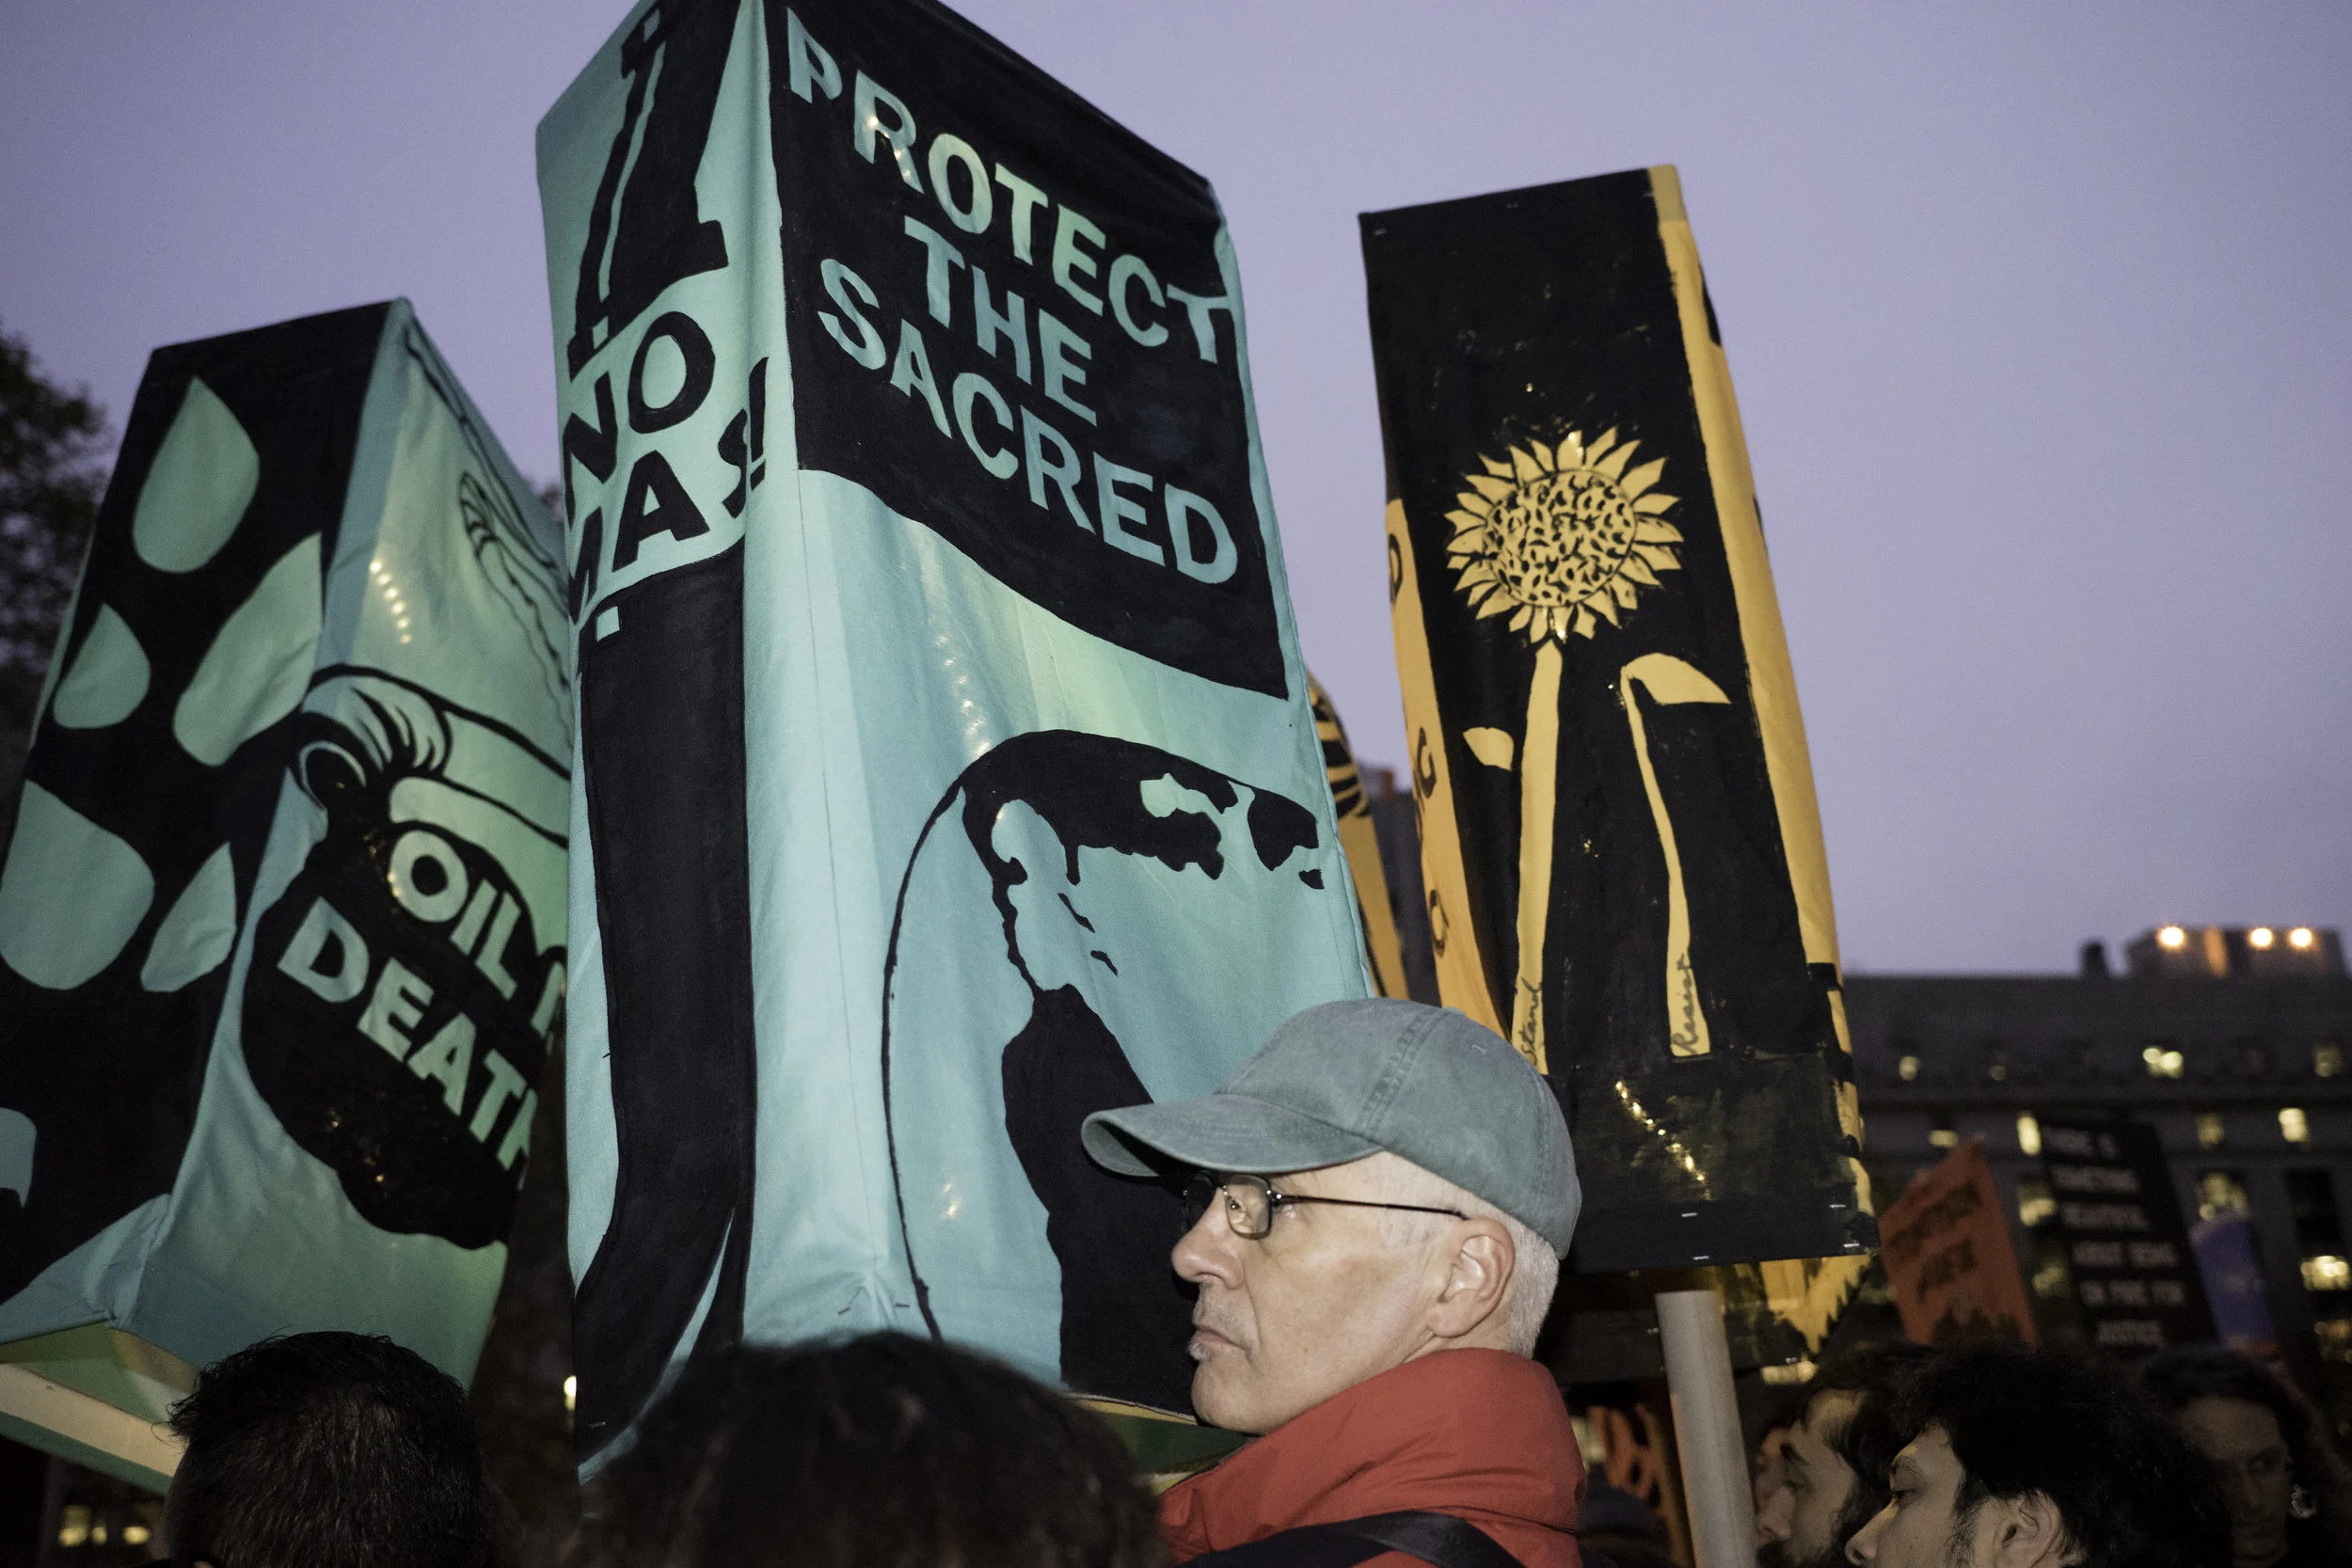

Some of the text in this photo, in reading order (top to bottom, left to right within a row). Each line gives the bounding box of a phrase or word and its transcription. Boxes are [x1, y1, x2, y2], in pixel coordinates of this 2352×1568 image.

[787, 7, 1232, 363] PROTECT
[564, 310, 715, 532] NO
[818, 258, 1238, 585] SACRED
[904, 216, 1097, 426] THE
[388, 830, 521, 1000] OIL
